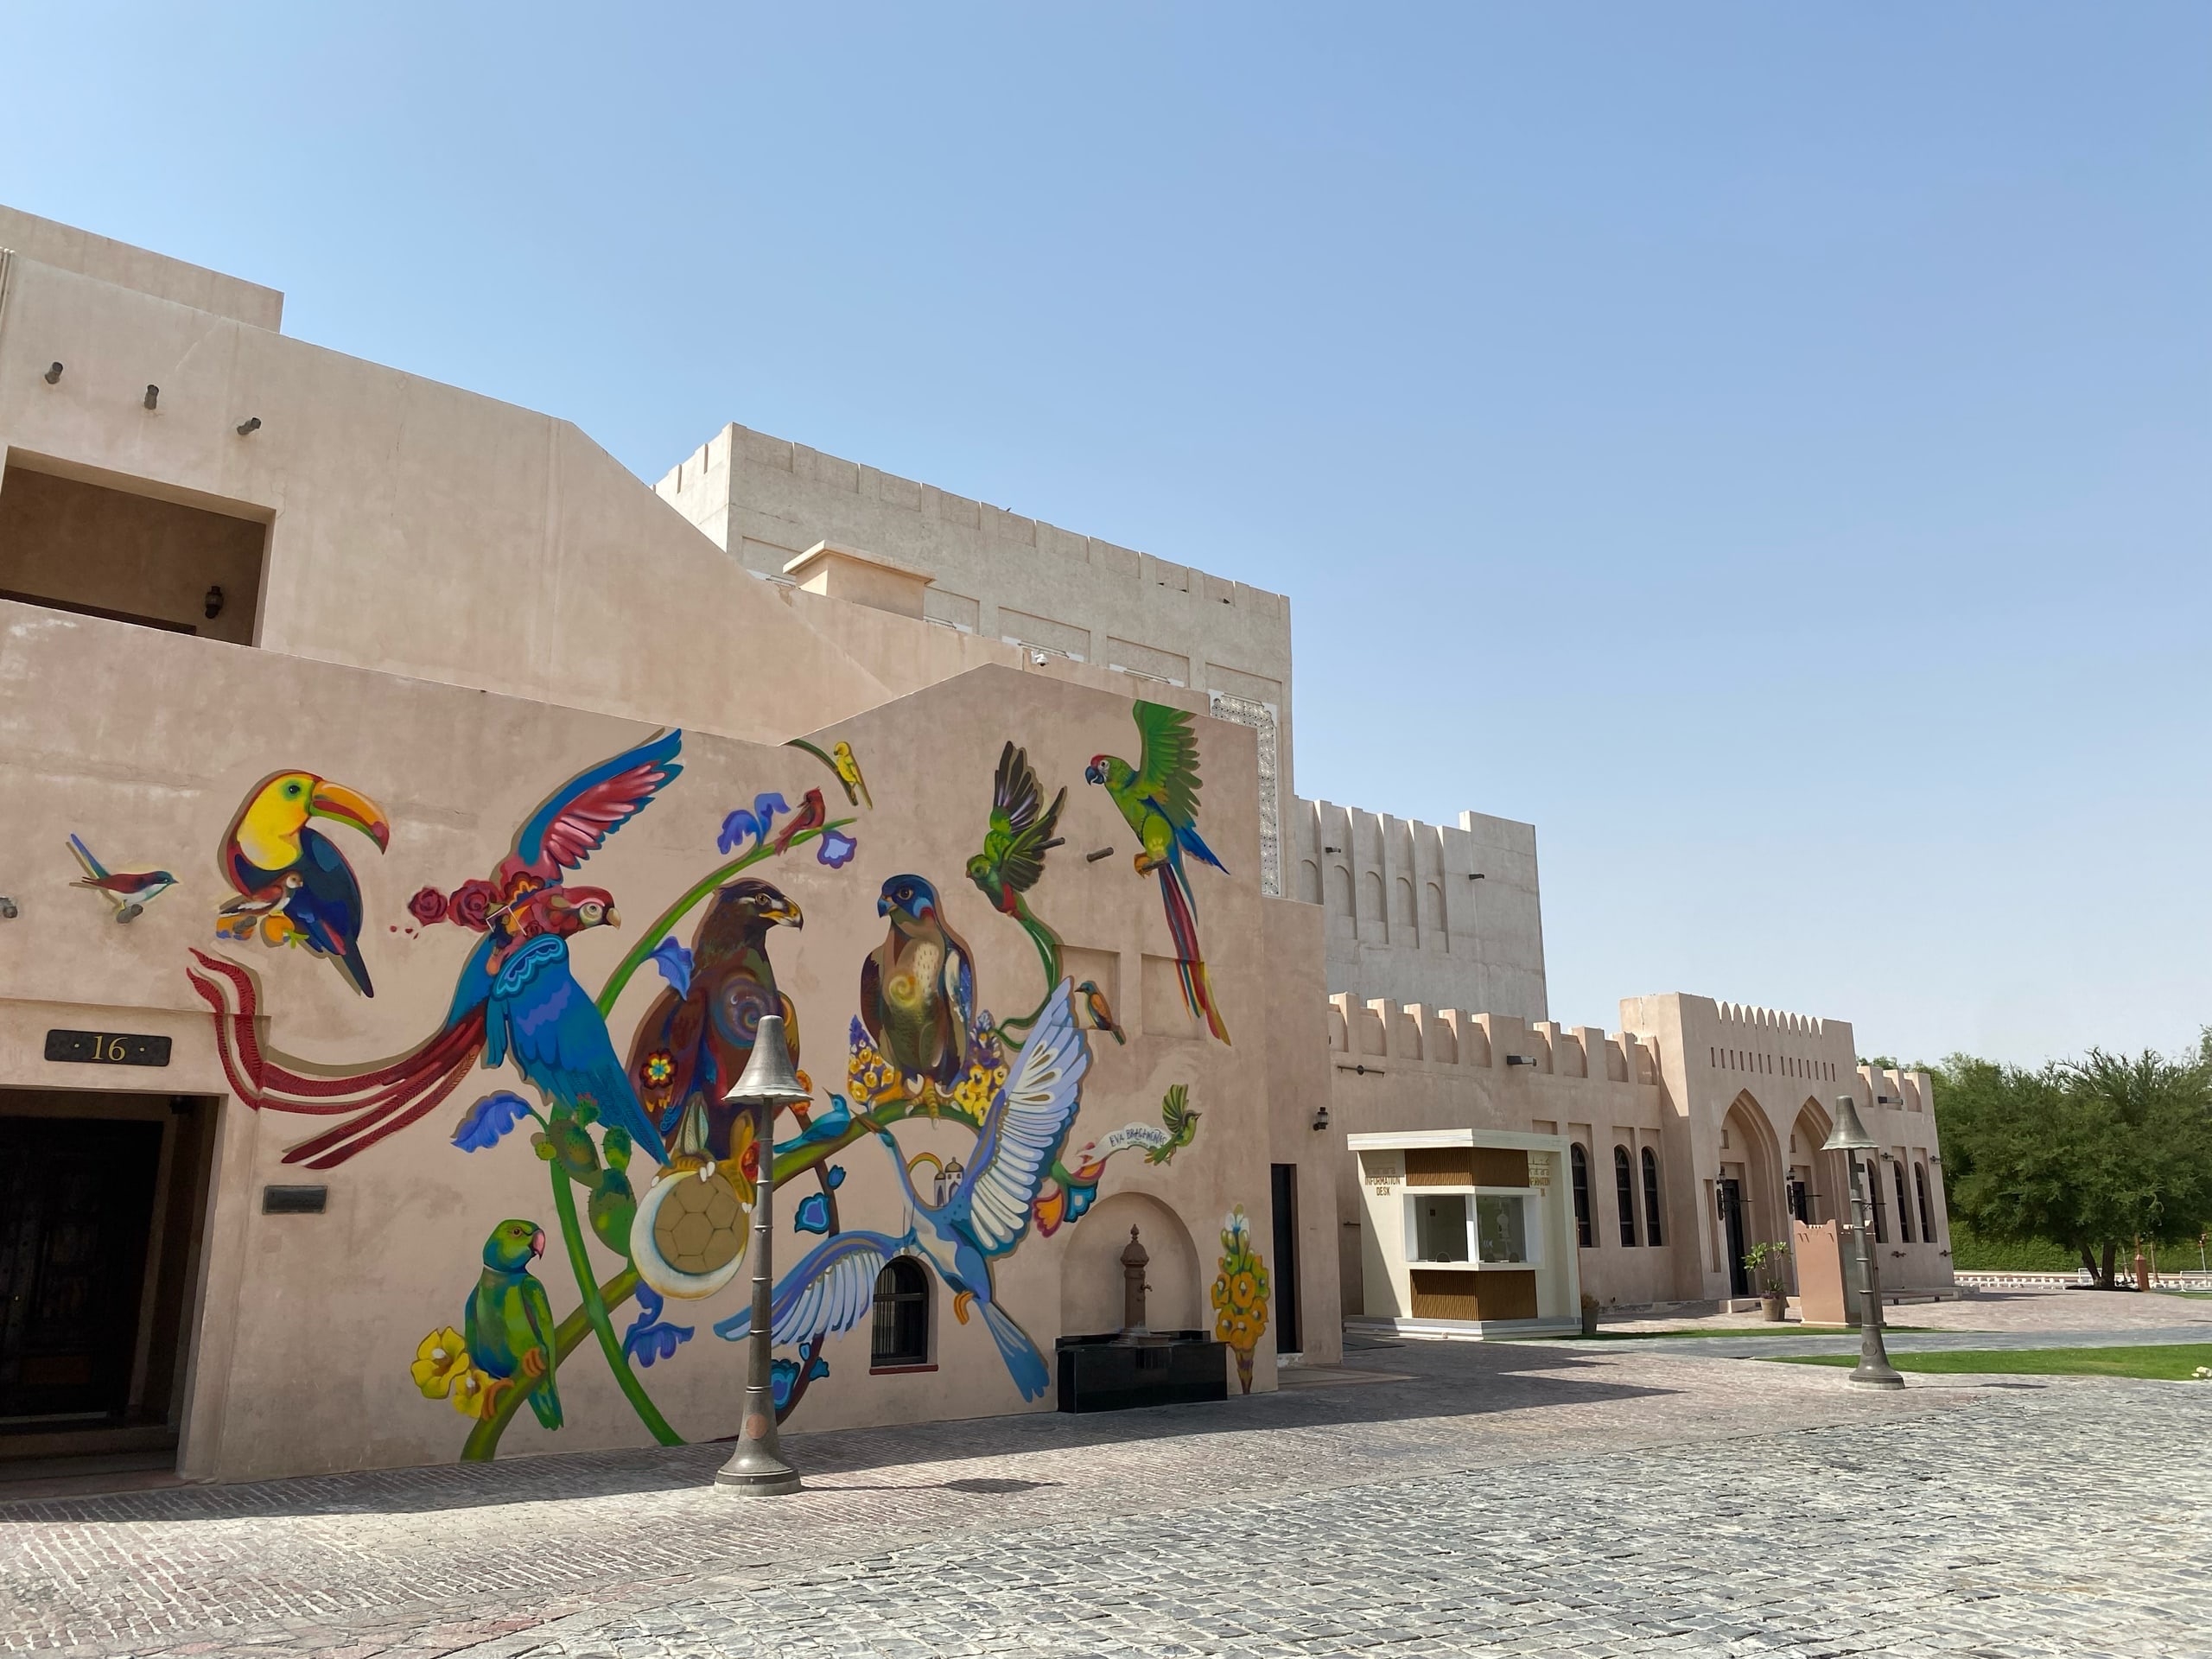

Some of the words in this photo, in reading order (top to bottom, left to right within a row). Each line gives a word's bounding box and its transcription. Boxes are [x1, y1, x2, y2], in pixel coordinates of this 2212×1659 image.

[91, 1035, 128, 1061] 16
[1109, 1134, 1124, 1147] EVA
[1365, 1176, 1401, 1185] INFORMATION
[1376, 1186, 1390, 1196] DESK
